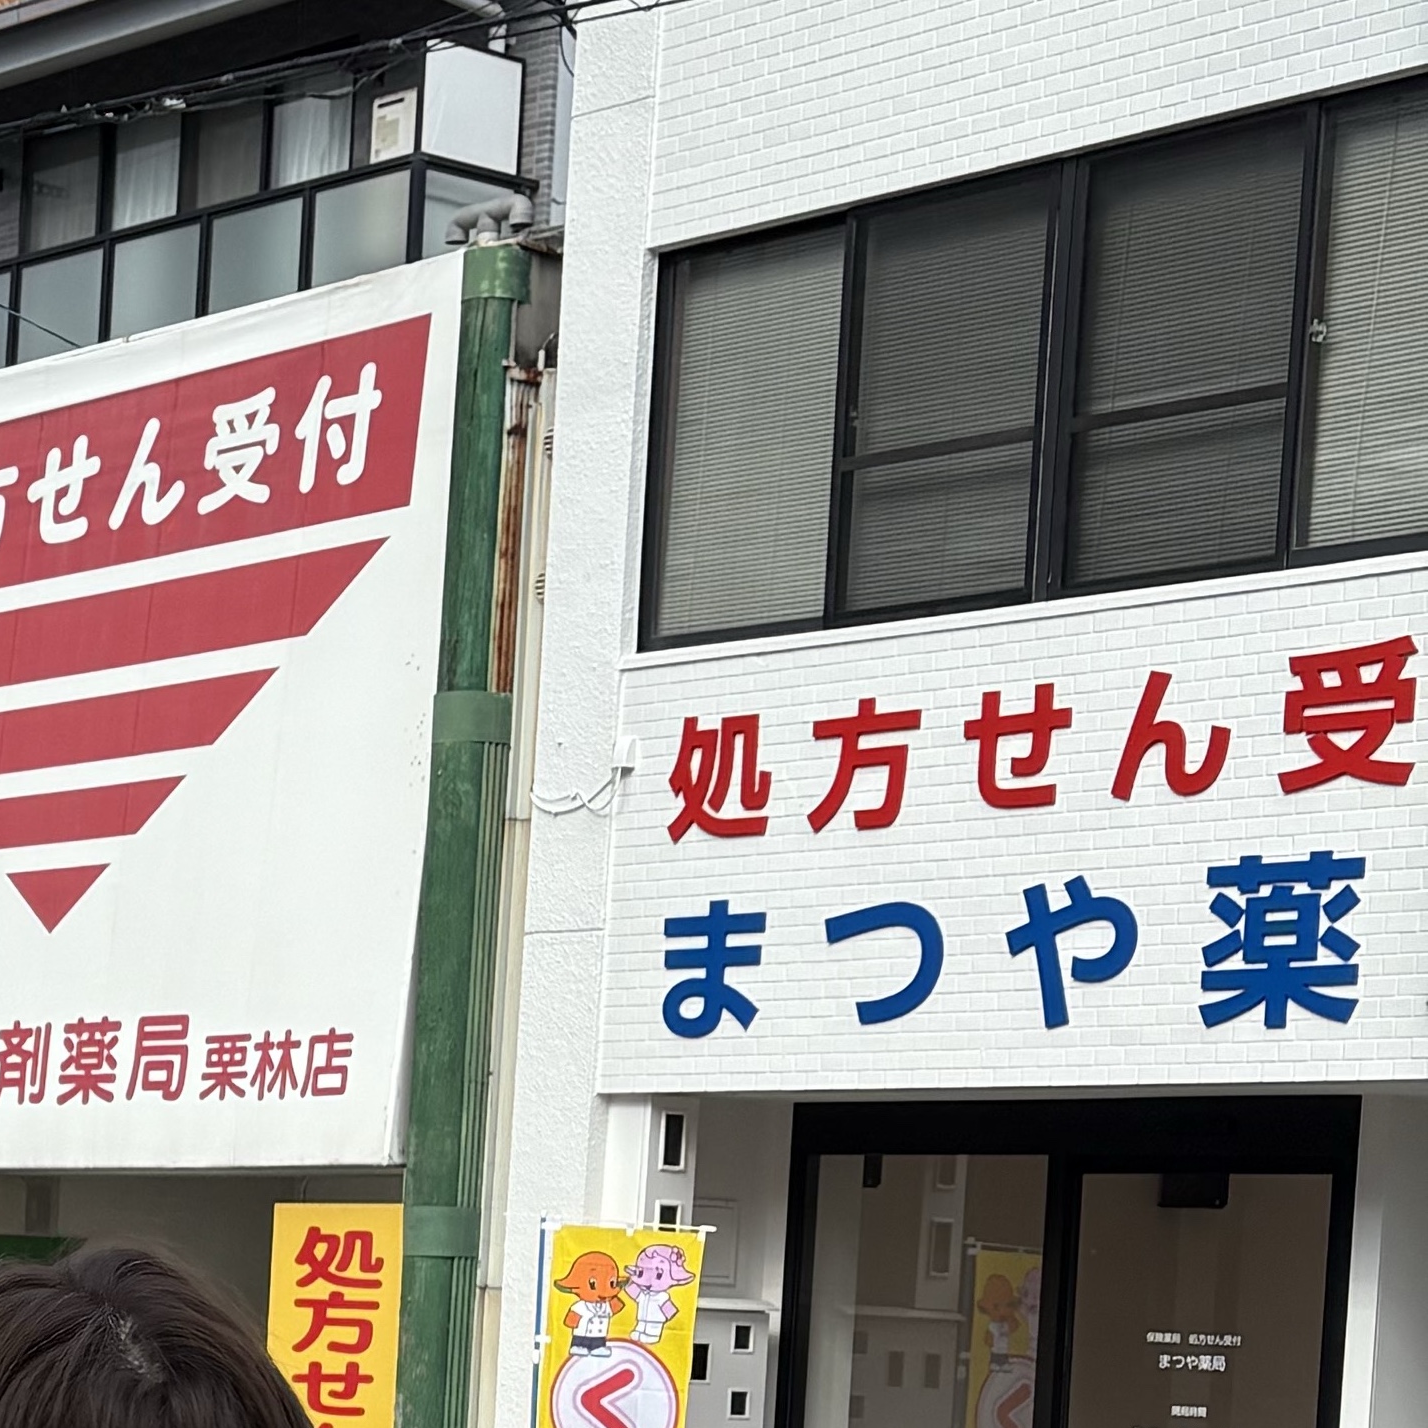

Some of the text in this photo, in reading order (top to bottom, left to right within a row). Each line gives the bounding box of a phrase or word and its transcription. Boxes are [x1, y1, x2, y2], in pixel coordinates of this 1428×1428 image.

[667, 634, 1420, 844] 処方せん受
[661, 850, 1368, 1039] まつや薬
